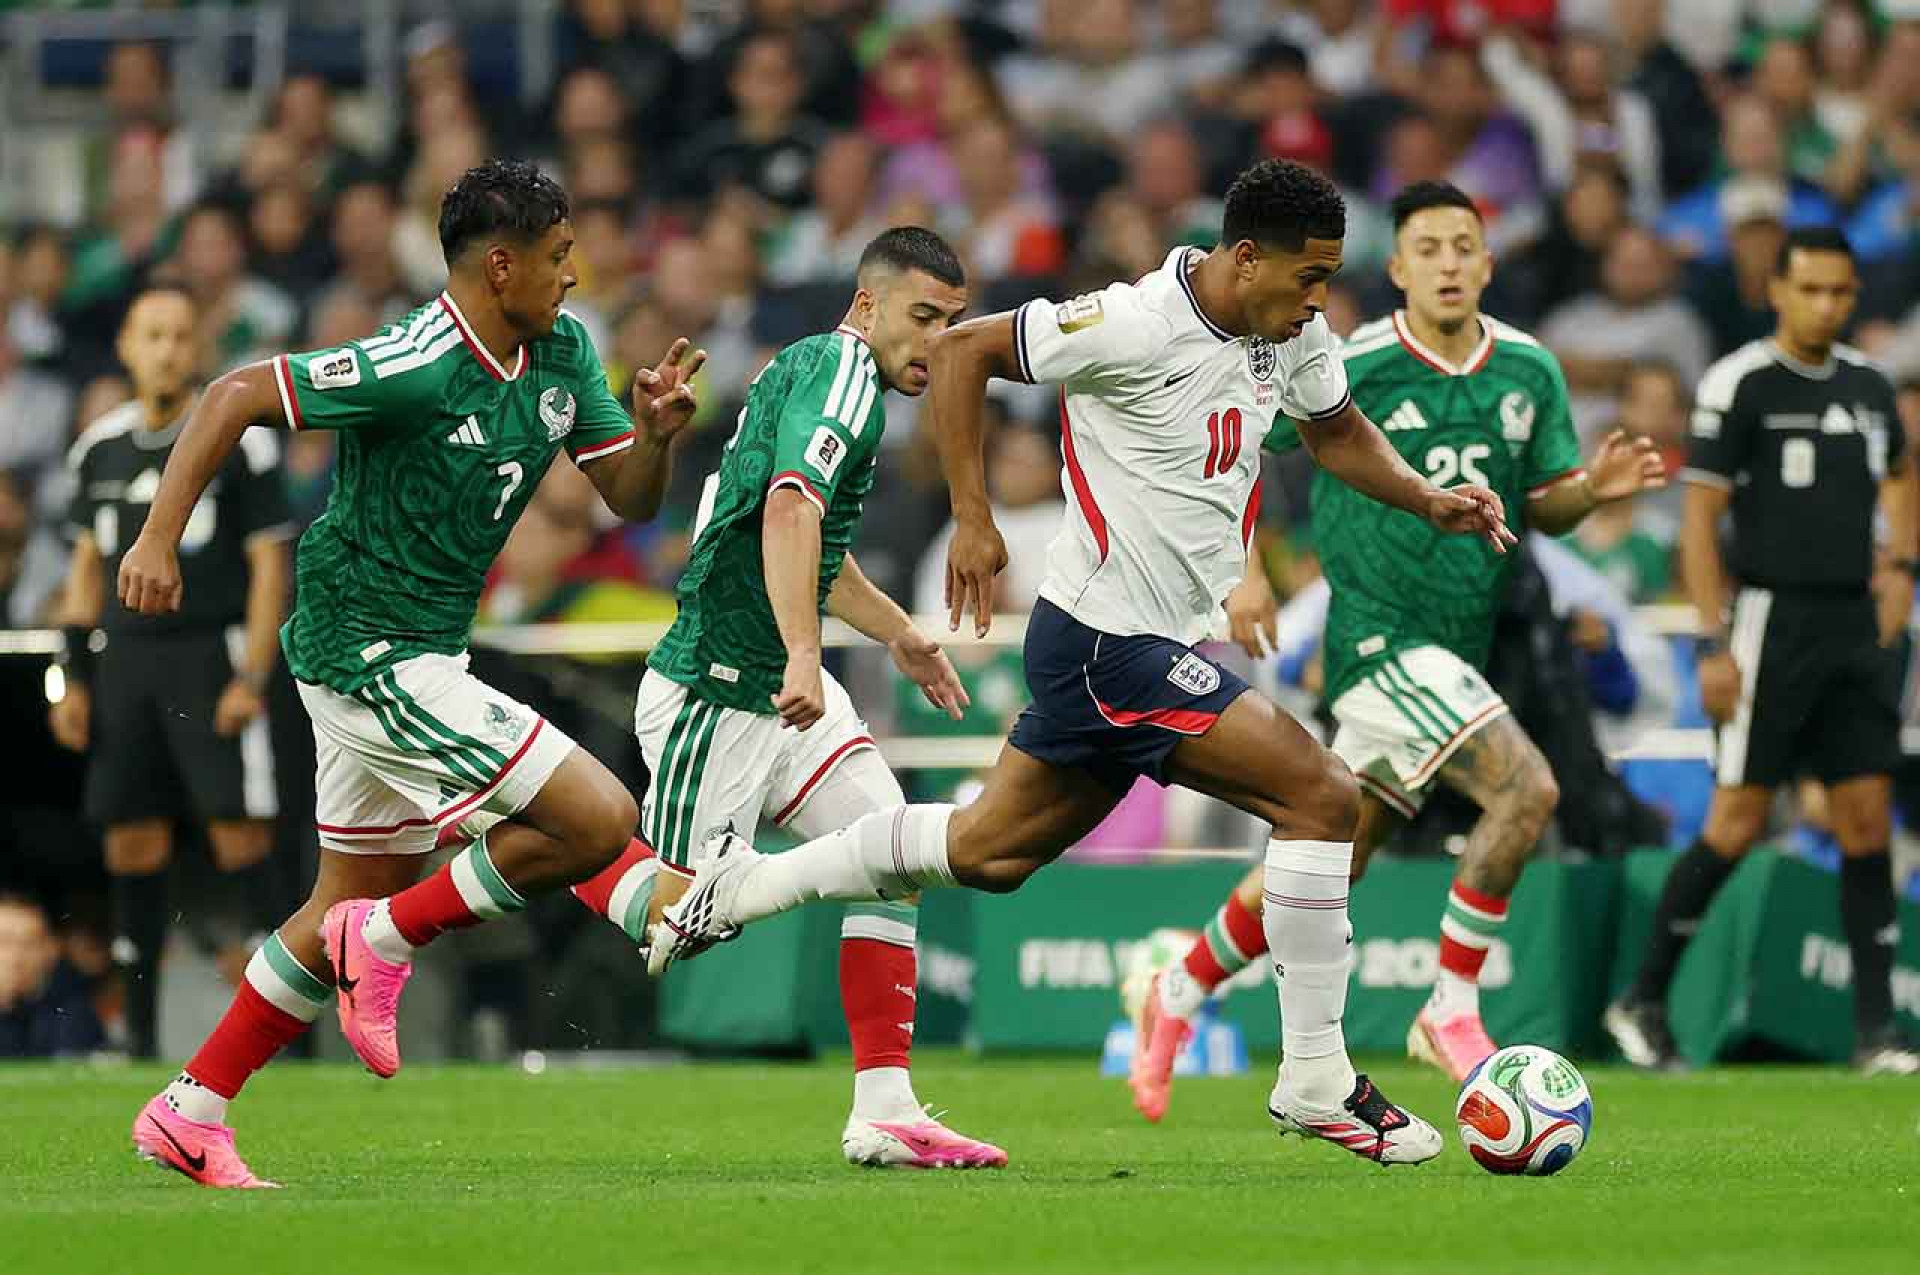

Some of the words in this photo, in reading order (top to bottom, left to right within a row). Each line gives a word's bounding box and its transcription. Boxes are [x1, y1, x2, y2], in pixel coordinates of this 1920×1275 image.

[1204, 408, 1242, 479] 10
[1425, 443, 1491, 488] 25
[493, 461, 523, 520] 7
[1020, 938, 1113, 989] FIFA
